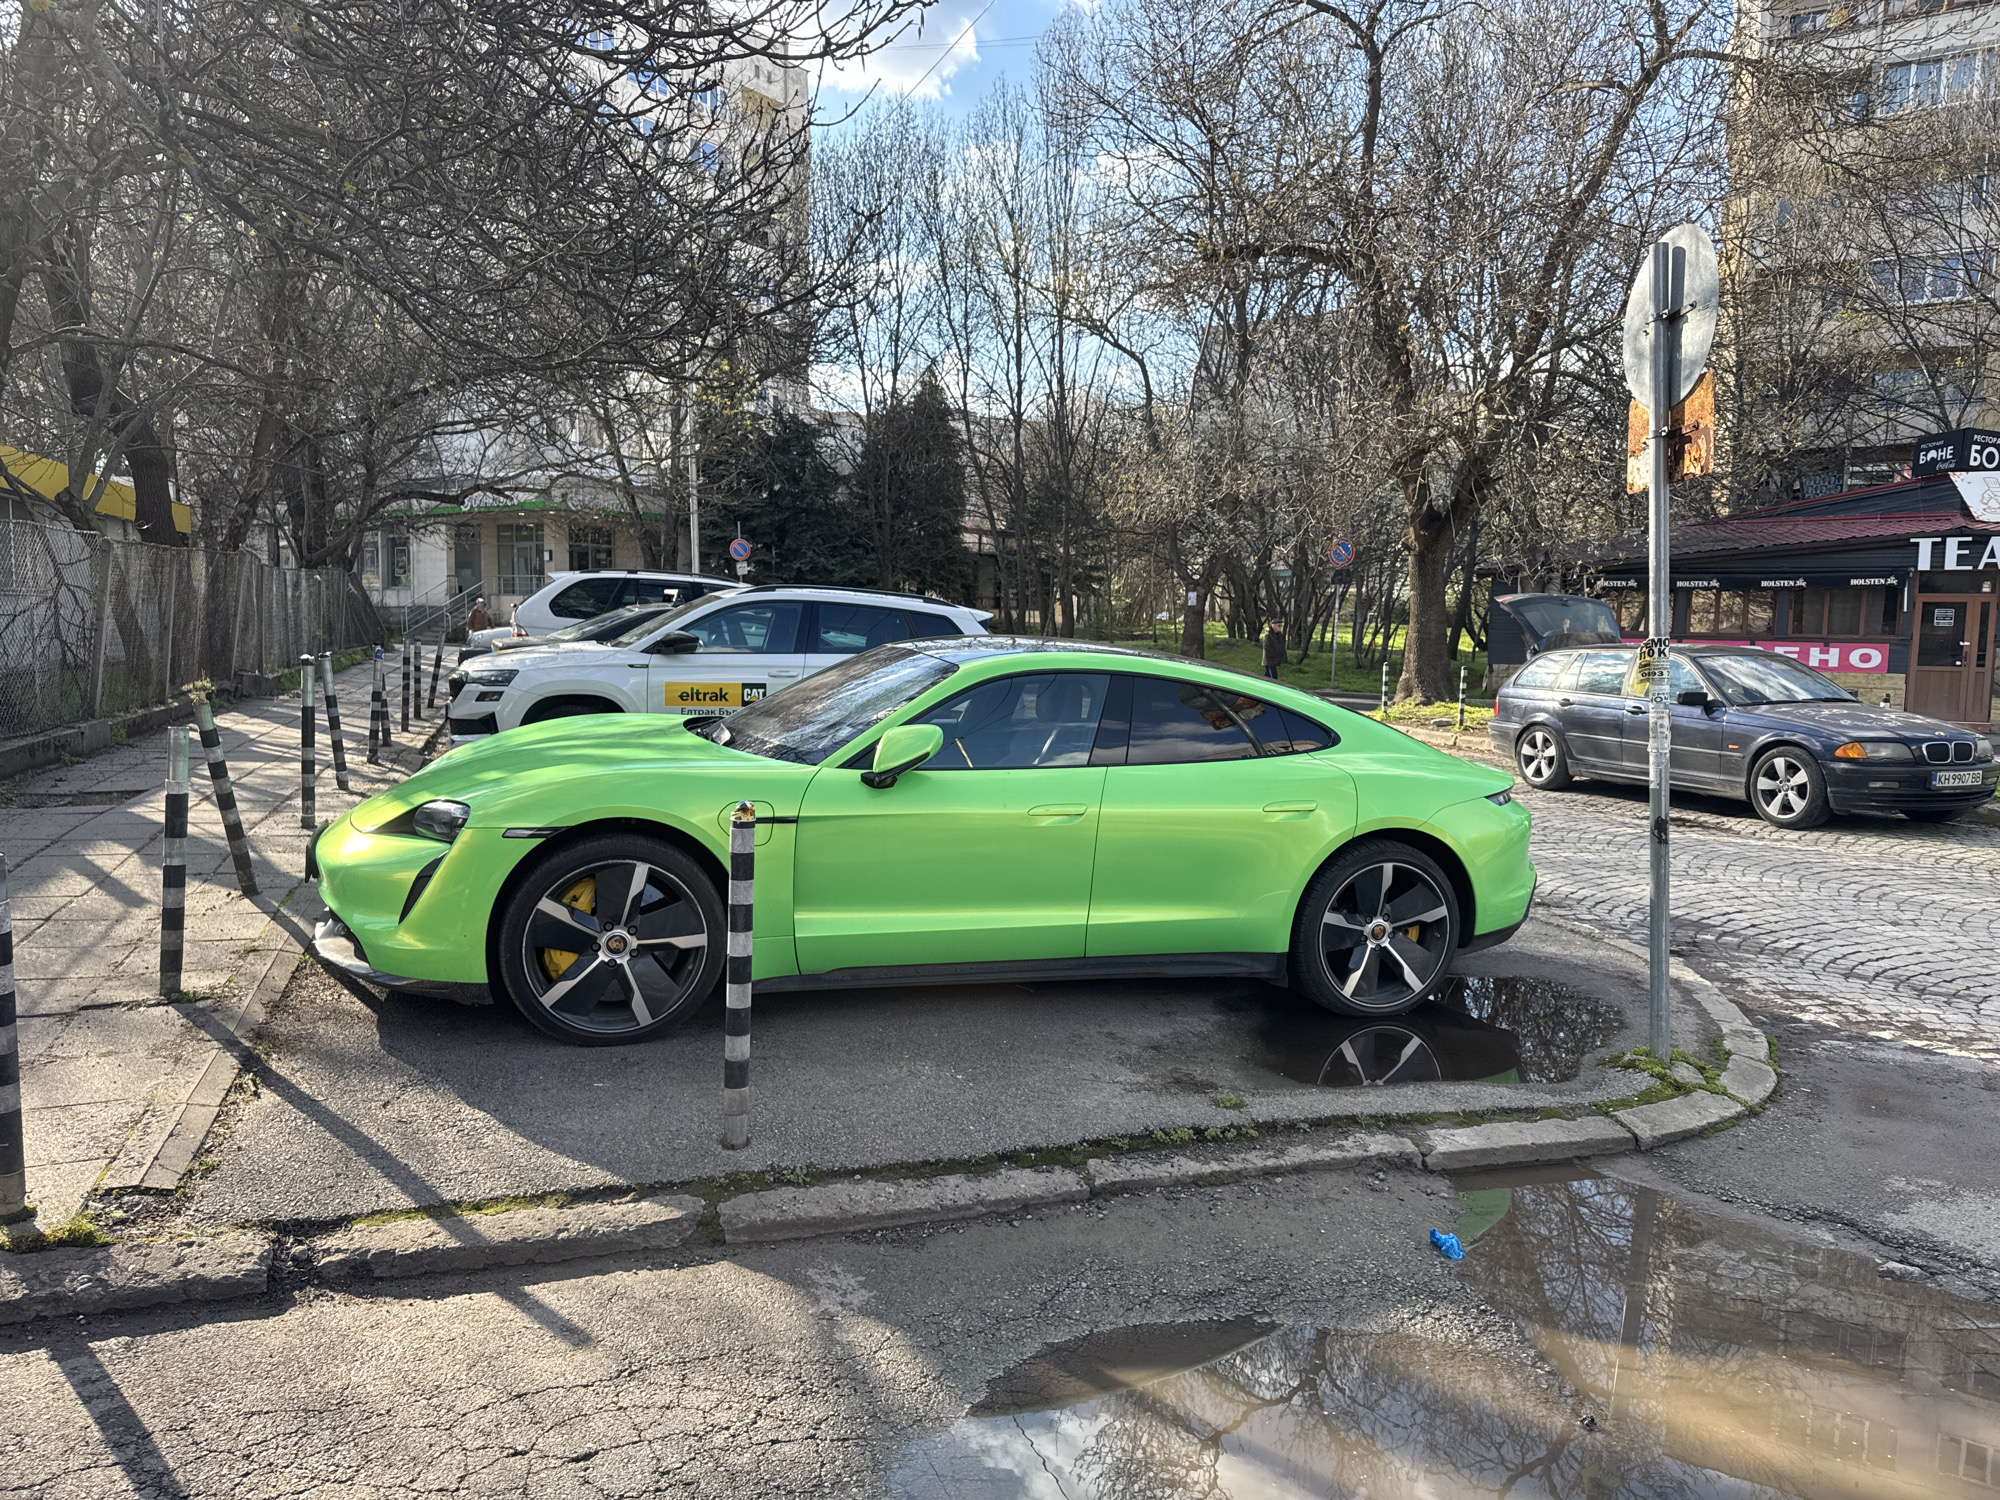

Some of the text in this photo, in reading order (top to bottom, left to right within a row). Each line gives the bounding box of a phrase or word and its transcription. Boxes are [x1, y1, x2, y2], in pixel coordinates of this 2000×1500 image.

[1676, 580, 1709, 588] HOLSTEN
[1761, 579, 1795, 588] HOLSTEN
[1850, 578, 1886, 586] HOLSTEN
[678, 687, 766, 702] eltrak CAT
[680, 707, 716, 716] Елтрак
